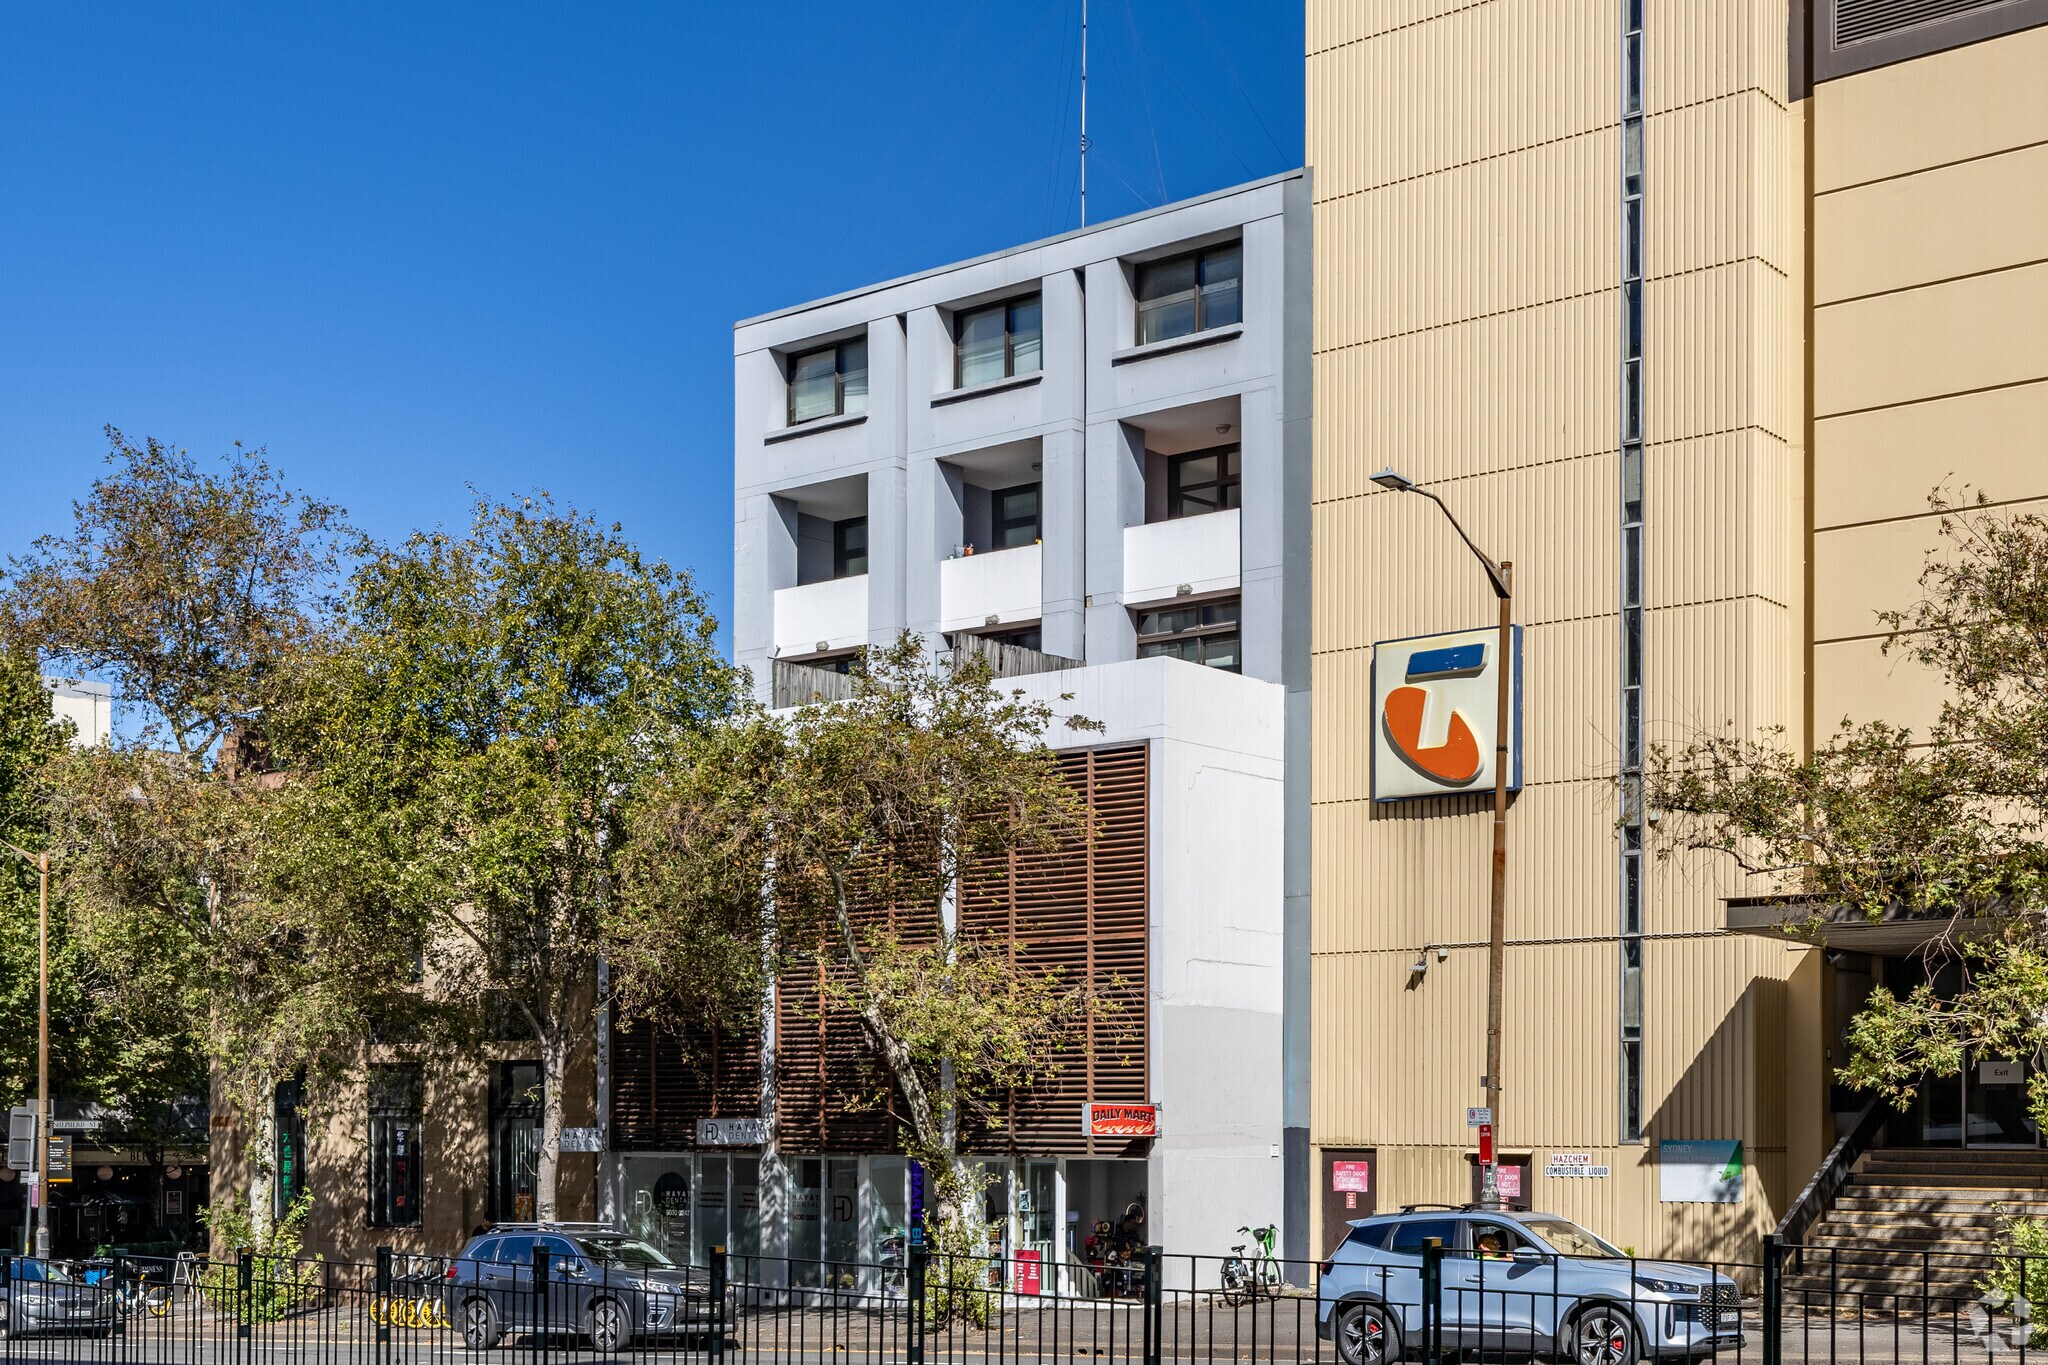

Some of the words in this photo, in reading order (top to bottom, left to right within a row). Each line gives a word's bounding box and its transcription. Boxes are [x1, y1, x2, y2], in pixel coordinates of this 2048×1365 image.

[1094, 1109, 1121, 1120] DAILY
[1124, 1109, 1153, 1122] MART
[564, 1131, 600, 1140] HAYAT
[1663, 1144, 1693, 1153] SYDNEY
[1553, 1155, 1589, 1163] HAZCHEM
[1545, 1167, 1584, 1175] COMBUSTIBLE
[1588, 1167, 1608, 1175] LIQUID
